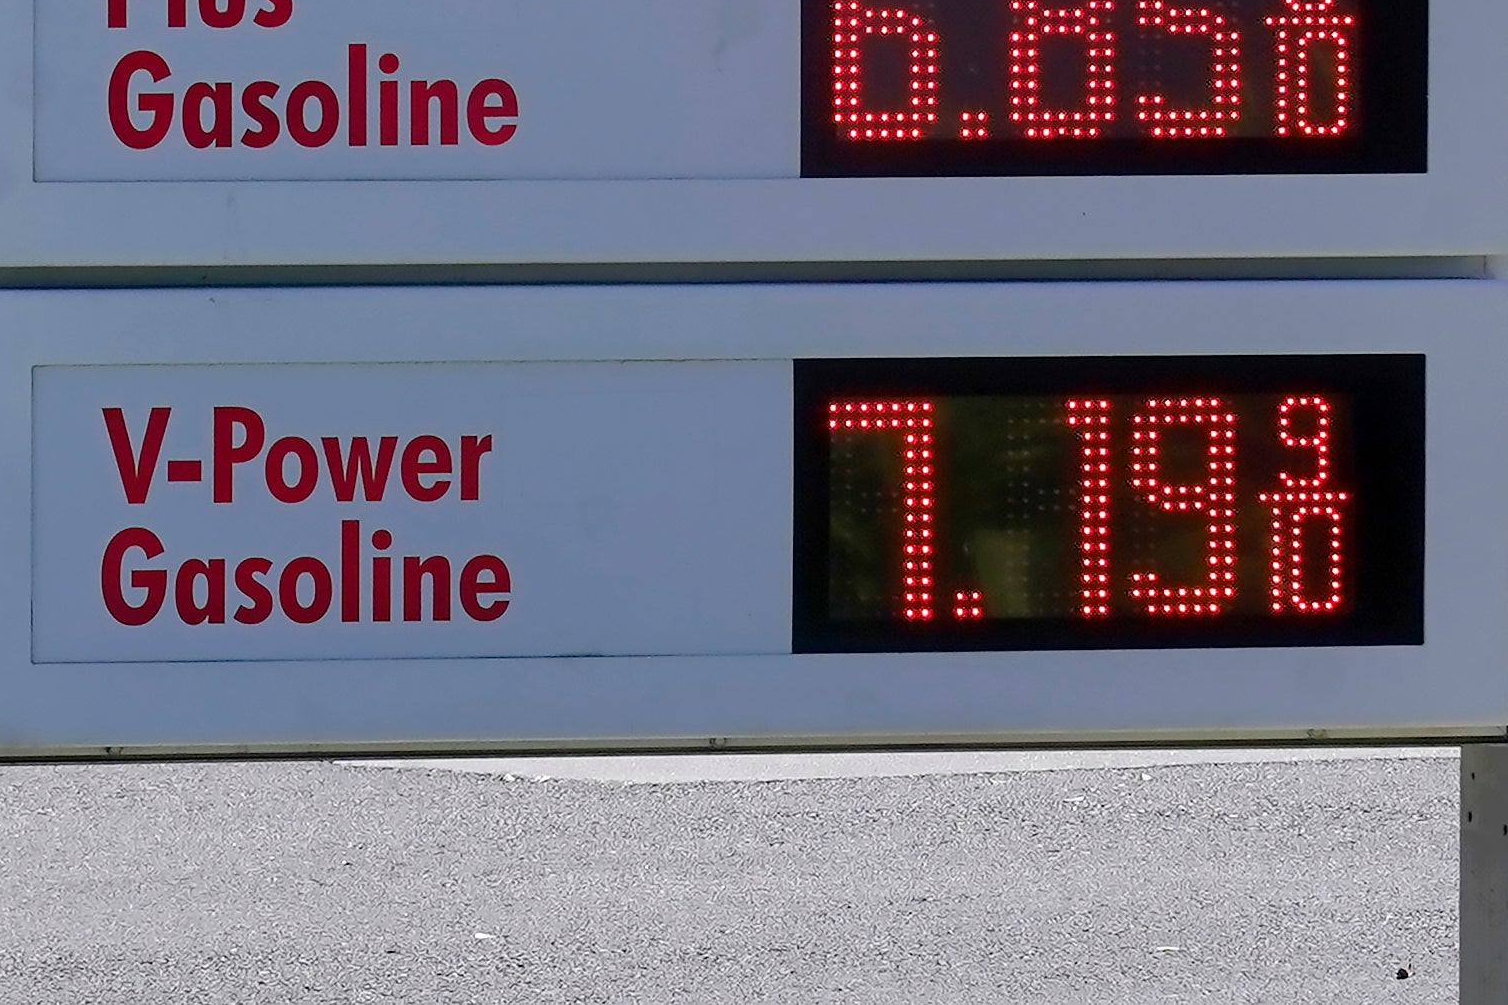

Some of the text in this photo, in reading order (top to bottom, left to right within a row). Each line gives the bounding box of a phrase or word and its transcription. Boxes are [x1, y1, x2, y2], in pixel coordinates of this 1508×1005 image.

[108, 43, 519, 150] Gasoline
[101, 406, 493, 504] V-Power
[827, 398, 1237, 619] 7.19
[101, 519, 511, 627] Gasoline
